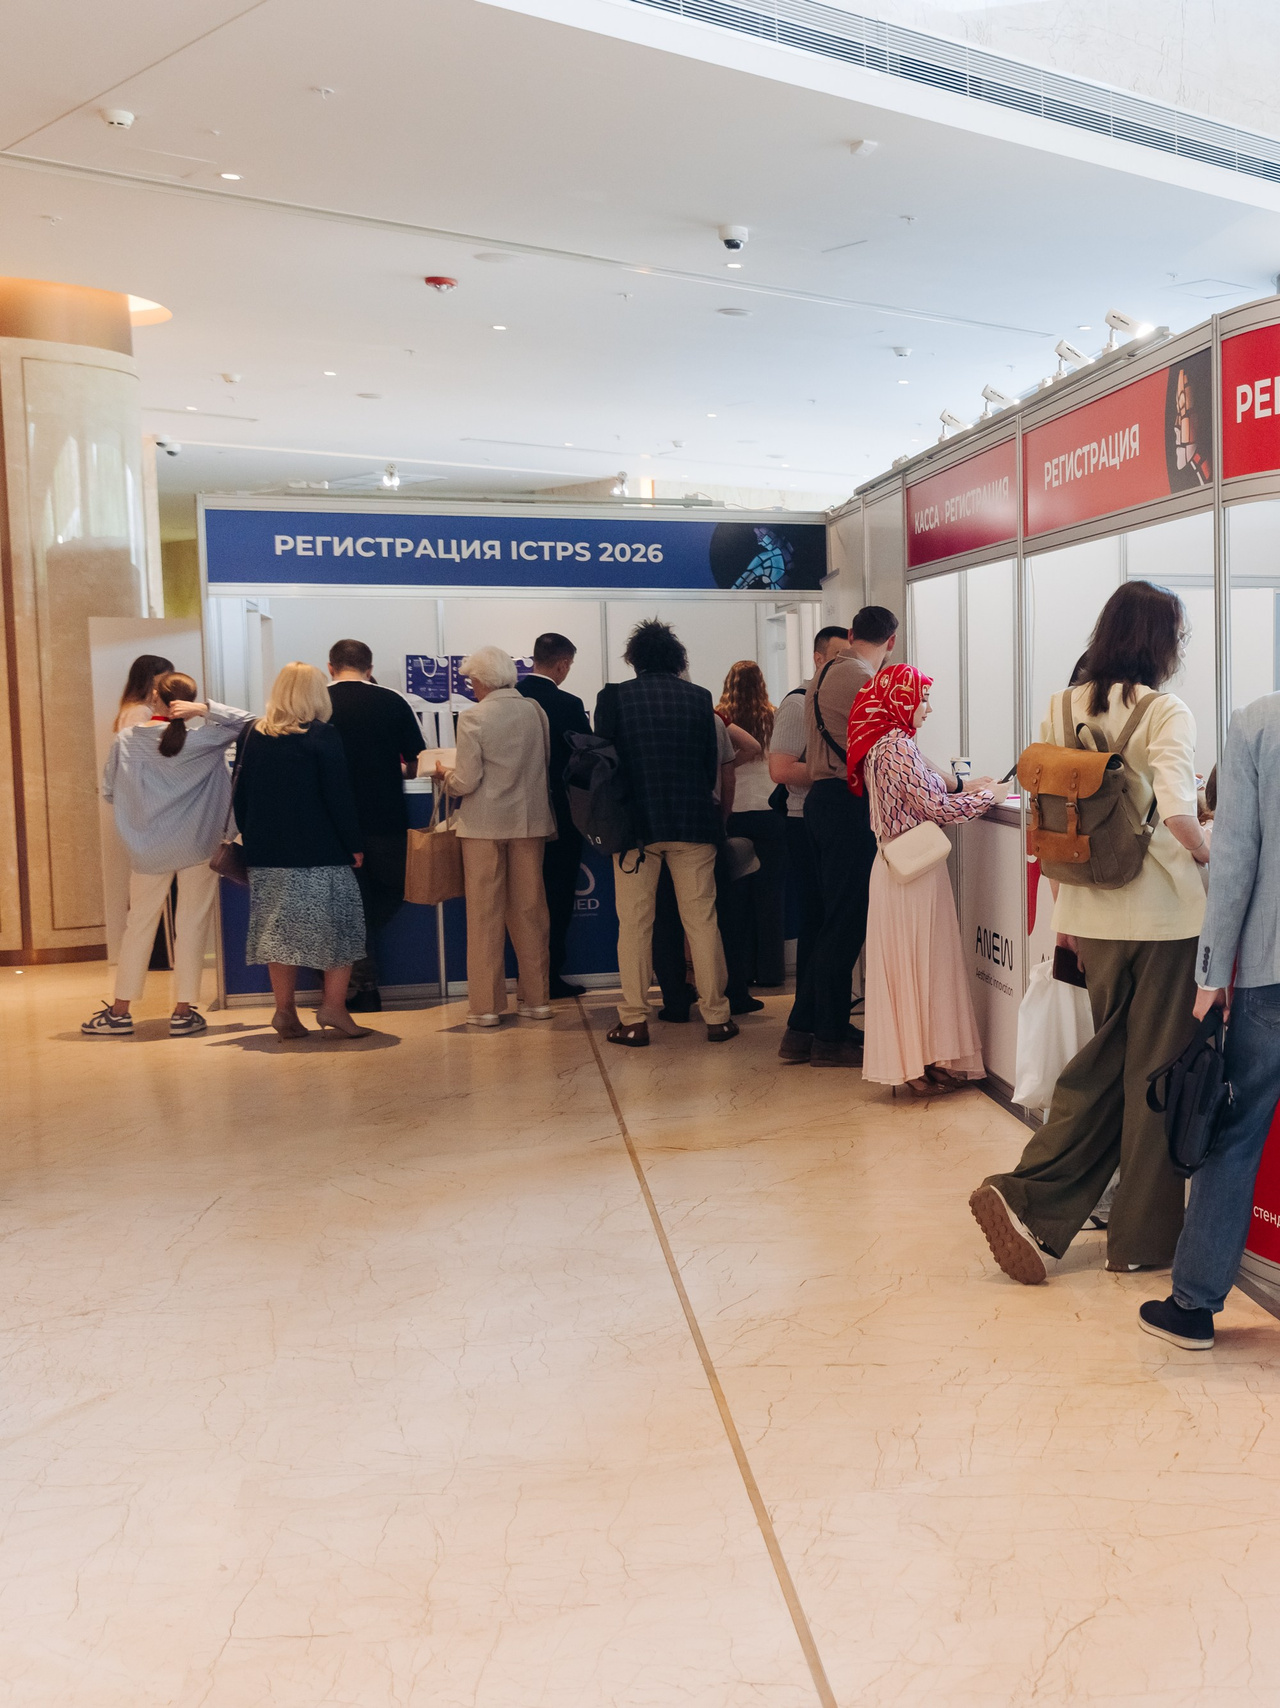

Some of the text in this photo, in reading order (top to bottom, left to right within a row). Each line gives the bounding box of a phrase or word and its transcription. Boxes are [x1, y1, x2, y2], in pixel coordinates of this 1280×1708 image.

[1044, 424, 1140, 490] РЕГИСТРАЦИЯ
[914, 476, 1009, 534] КАССА РЕГИСТРАЦИЯ
[274, 535, 664, 563] РЕГИСТРАЦИЯ ICTPS 2026
[976, 925, 1013, 971] ANEW
